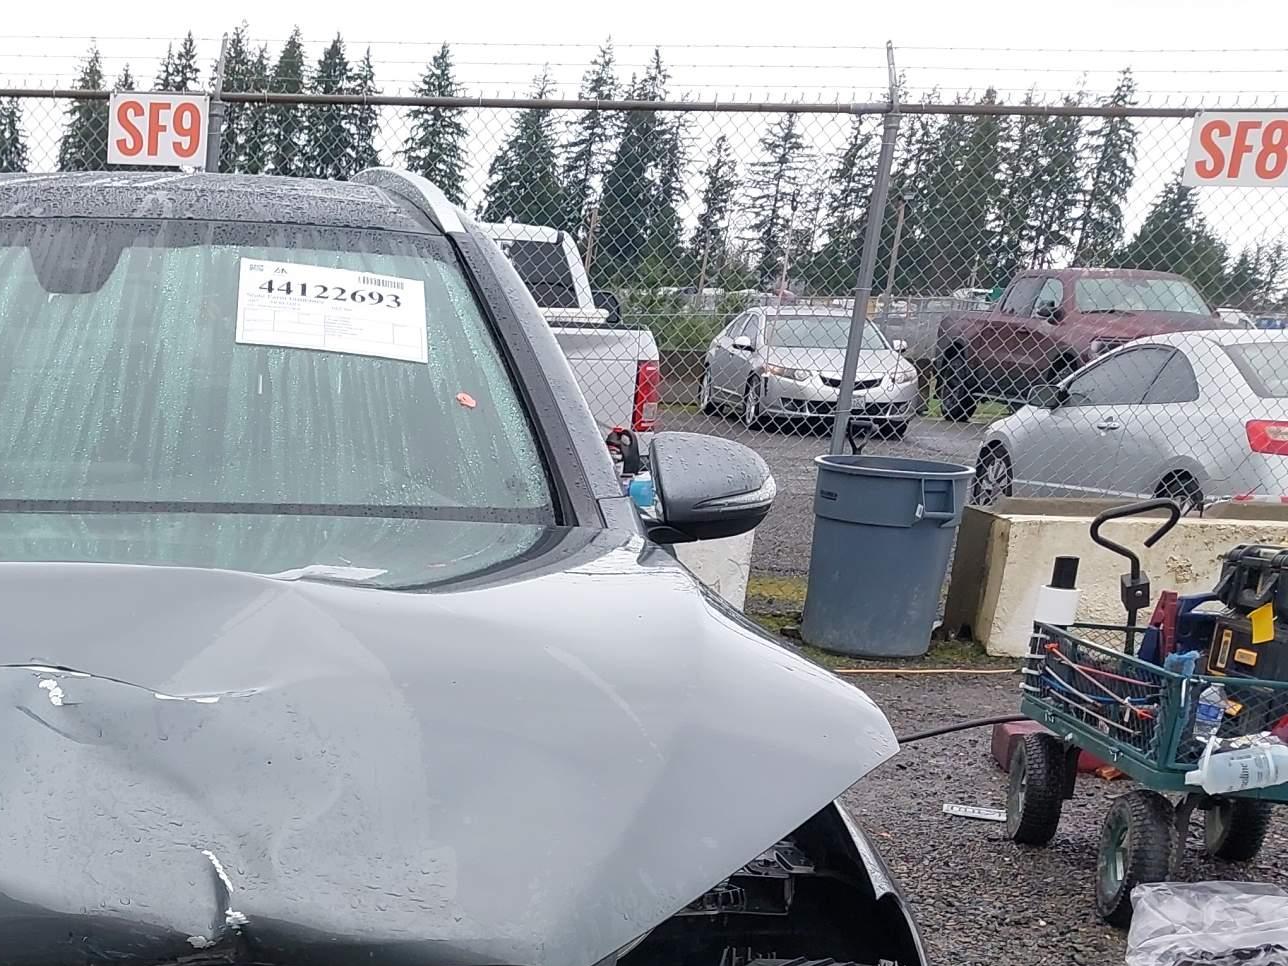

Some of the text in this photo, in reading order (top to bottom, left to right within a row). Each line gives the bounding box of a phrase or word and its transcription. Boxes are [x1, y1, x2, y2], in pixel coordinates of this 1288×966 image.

[115, 100, 201, 158] SF9
[1194, 119, 1288, 180] SF8
[258, 279, 402, 309] 44122693
